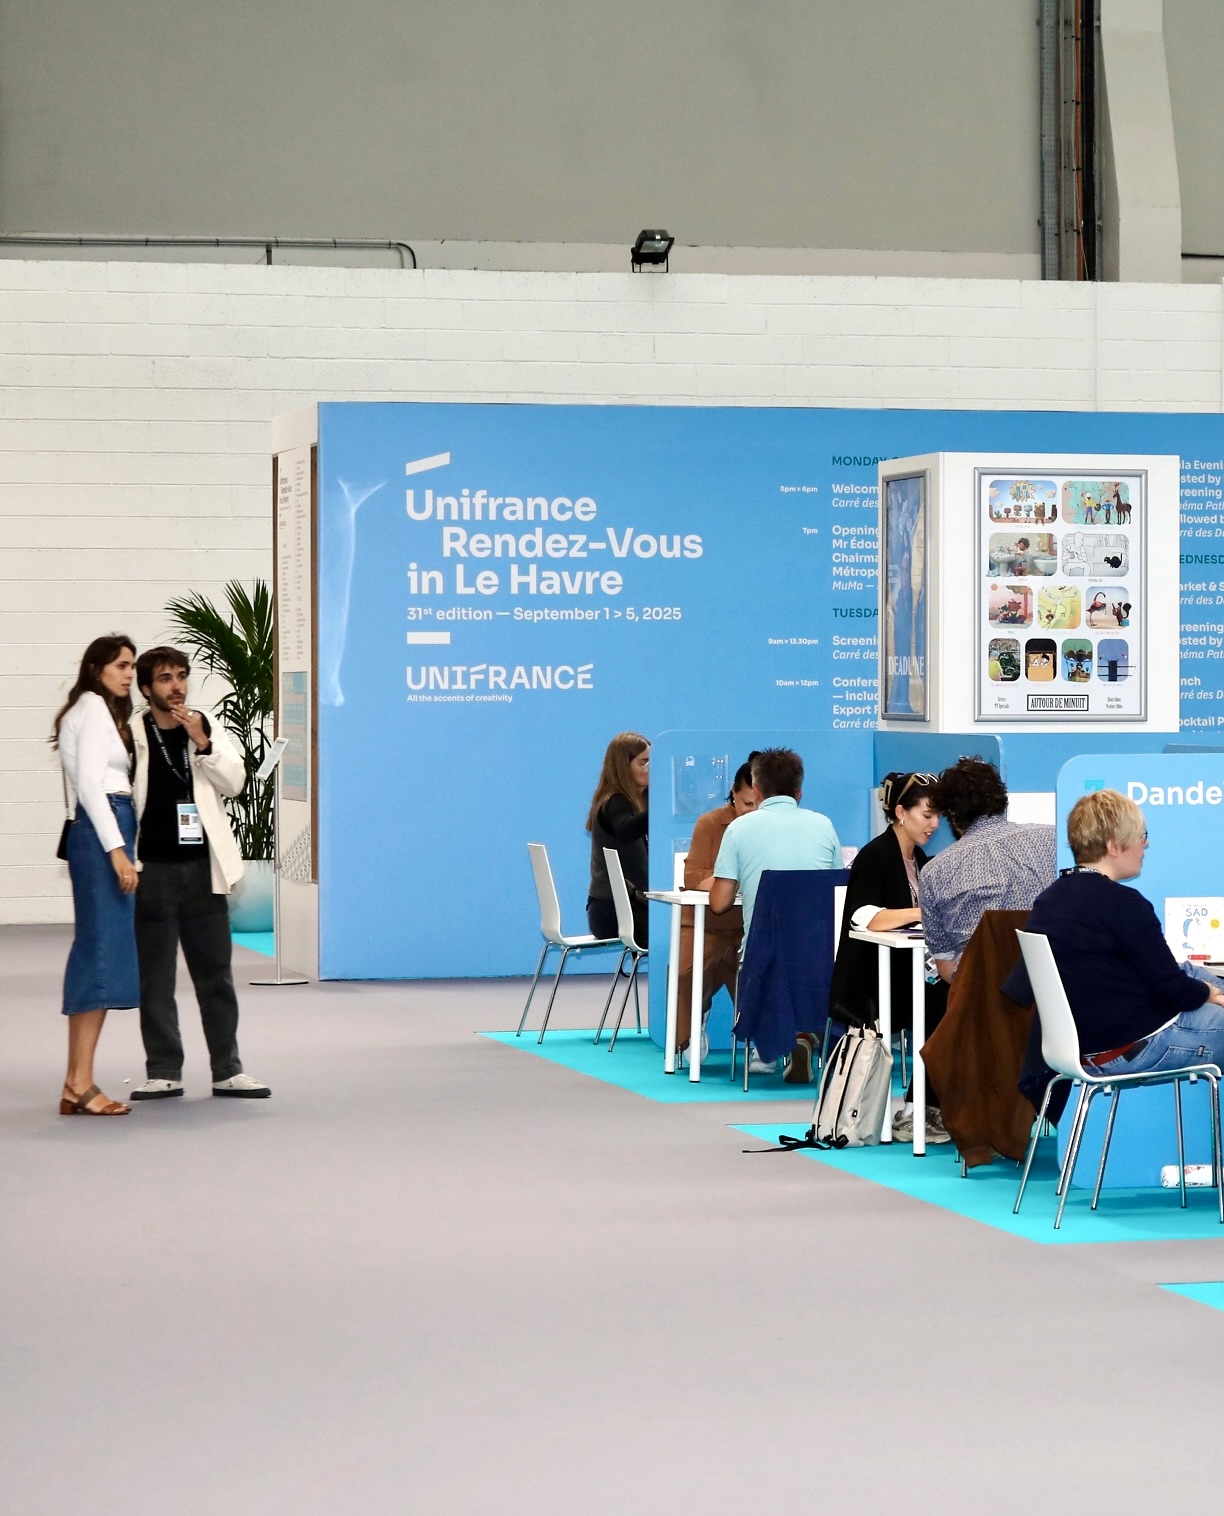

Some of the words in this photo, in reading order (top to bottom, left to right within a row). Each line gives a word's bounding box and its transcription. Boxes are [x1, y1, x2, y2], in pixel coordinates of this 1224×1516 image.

[1207, 474, 1221, 485] by
[406, 489, 597, 521] Unifrance
[832, 498, 860, 507] Carré
[862, 498, 879, 507] des
[802, 527, 818, 535] 7pm
[1195, 528, 1212, 537] des
[442, 527, 704, 558] Rendez-Vous
[832, 539, 848, 548] Mr
[407, 562, 444, 594] in
[456, 563, 499, 595] Le
[510, 563, 623, 595] Havre
[832, 581, 863, 590] MuMa
[1209, 582, 1217, 591] &
[1196, 595, 1213, 605] des
[406, 607, 433, 620] 31st
[436, 607, 493, 620] edition
[513, 607, 601, 623] September
[604, 607, 610, 620] 1
[626, 607, 639, 622] 5,
[643, 607, 682, 620] 2025
[789, 638, 819, 646] 12.30pm
[1209, 636, 1223, 647] by
[832, 650, 861, 659] Carré
[863, 650, 879, 659] des
[407, 694, 418, 702] All
[419, 694, 432, 702] the
[466, 694, 475, 702] of
[475, 694, 513, 703] creativity
[1196, 690, 1213, 699] des
[1030, 697, 1054, 709] AUTOUR
[1054, 697, 1063, 709] DE
[1063, 697, 1086, 709] MINUIT
[833, 704, 871, 716] Export
[832, 719, 860, 729] Carré
[863, 719, 879, 729] des
[1185, 908, 1208, 917] SAD
